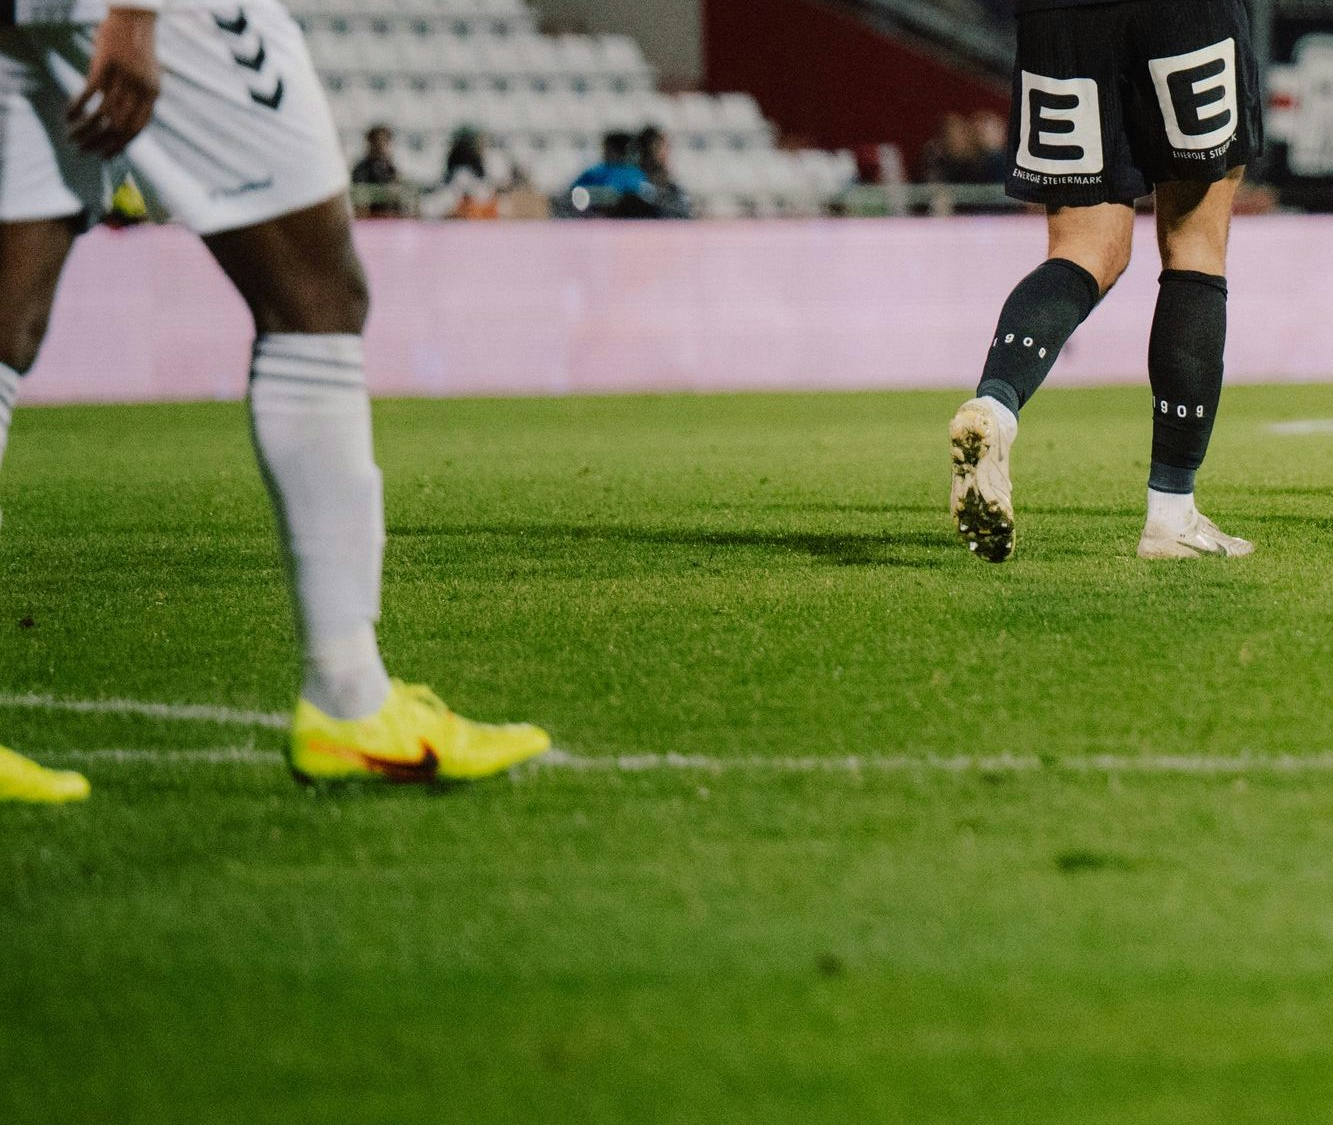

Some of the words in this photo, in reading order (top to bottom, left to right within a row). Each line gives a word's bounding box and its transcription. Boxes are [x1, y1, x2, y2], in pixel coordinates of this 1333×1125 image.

[1013, 168, 1041, 184] ENERGIE
[1042, 175, 1102, 185] STEIERMARK
[1152, 395, 1204, 419] 1909
